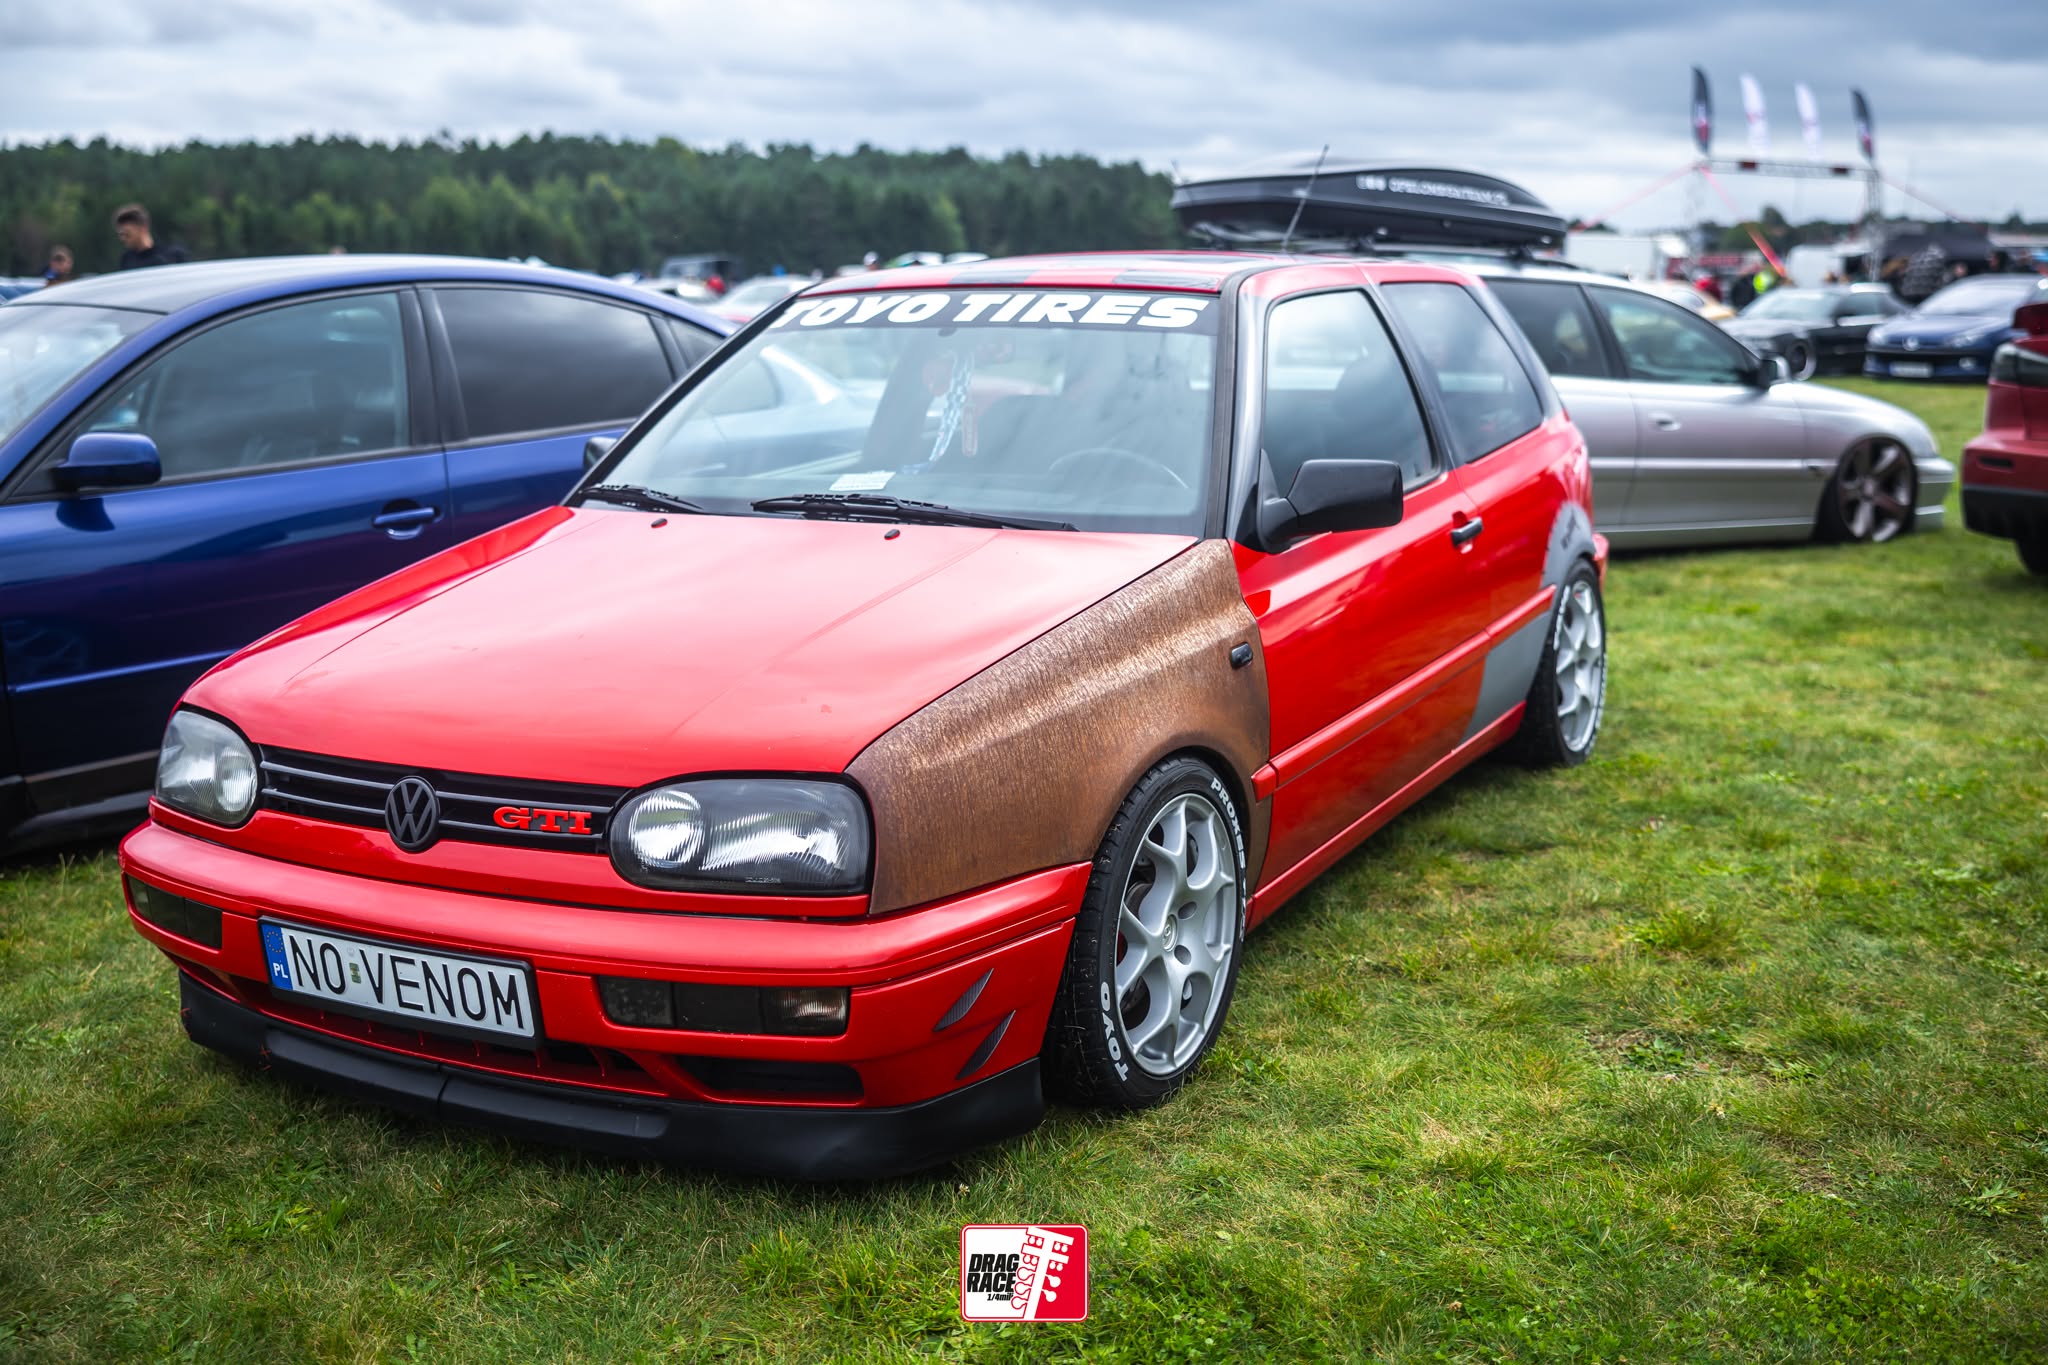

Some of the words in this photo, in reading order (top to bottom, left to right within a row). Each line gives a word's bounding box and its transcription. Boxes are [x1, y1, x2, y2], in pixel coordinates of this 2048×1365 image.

[769, 293, 951, 329] TOYO
[952, 293, 1210, 329] TIRES
[493, 806, 592, 835] GTI
[1210, 777, 1247, 869] PROXES
[273, 962, 288, 979] PL
[289, 934, 346, 995] NO
[359, 949, 525, 1030] VENOM
[1100, 981, 1129, 1082] TOYO
